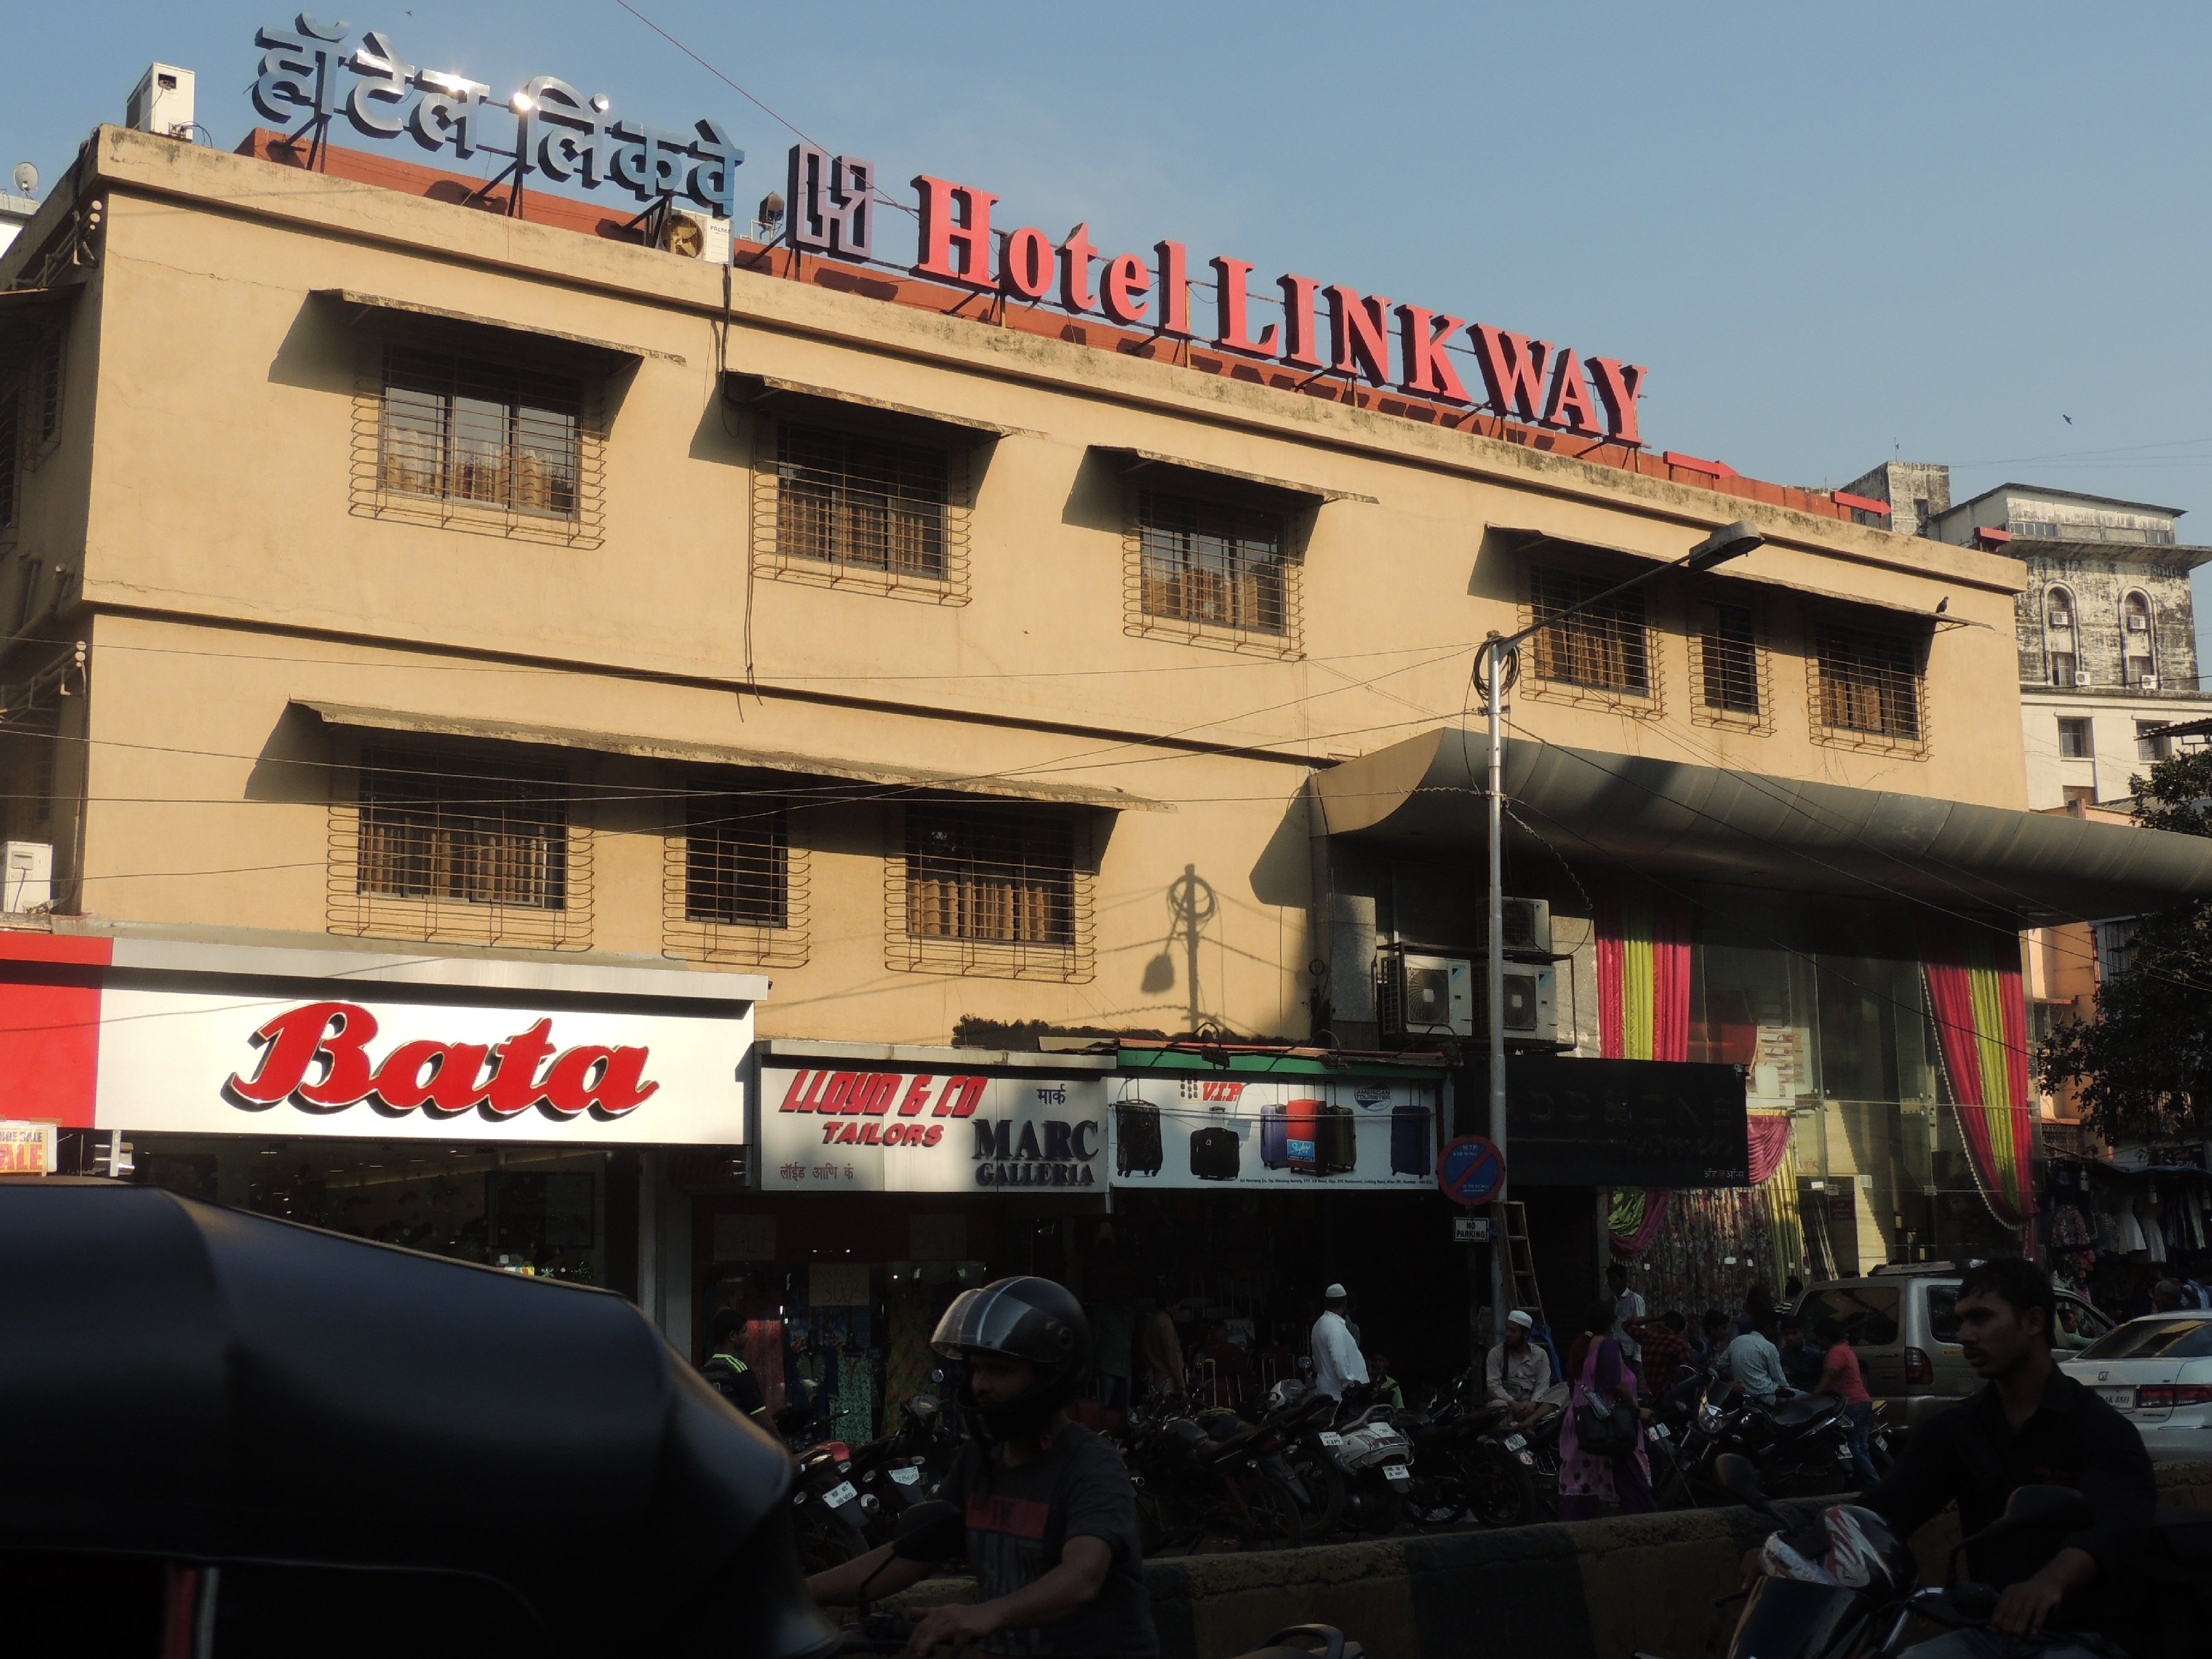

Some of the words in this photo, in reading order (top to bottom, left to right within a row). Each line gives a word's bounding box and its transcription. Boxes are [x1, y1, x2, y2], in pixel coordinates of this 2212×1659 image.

[252, 12, 489, 160] हॉटेल
[509, 75, 745, 219] लिंकवे
[909, 174, 1189, 339] Hotel
[1210, 256, 1648, 446] LINKWAY
[221, 1001, 660, 1121] Bata
[778, 1069, 902, 1115] LLOYD
[931, 1076, 988, 1118] CO
[1036, 1083, 1067, 1106] मार्क
[822, 1121, 944, 1147] TAILORS
[971, 1119, 1099, 1161] MARC
[813, 1162, 837, 1180] आणि
[975, 1162, 1096, 1186] GALLERIA
[1456, 1230, 1485, 1238] PARKING
